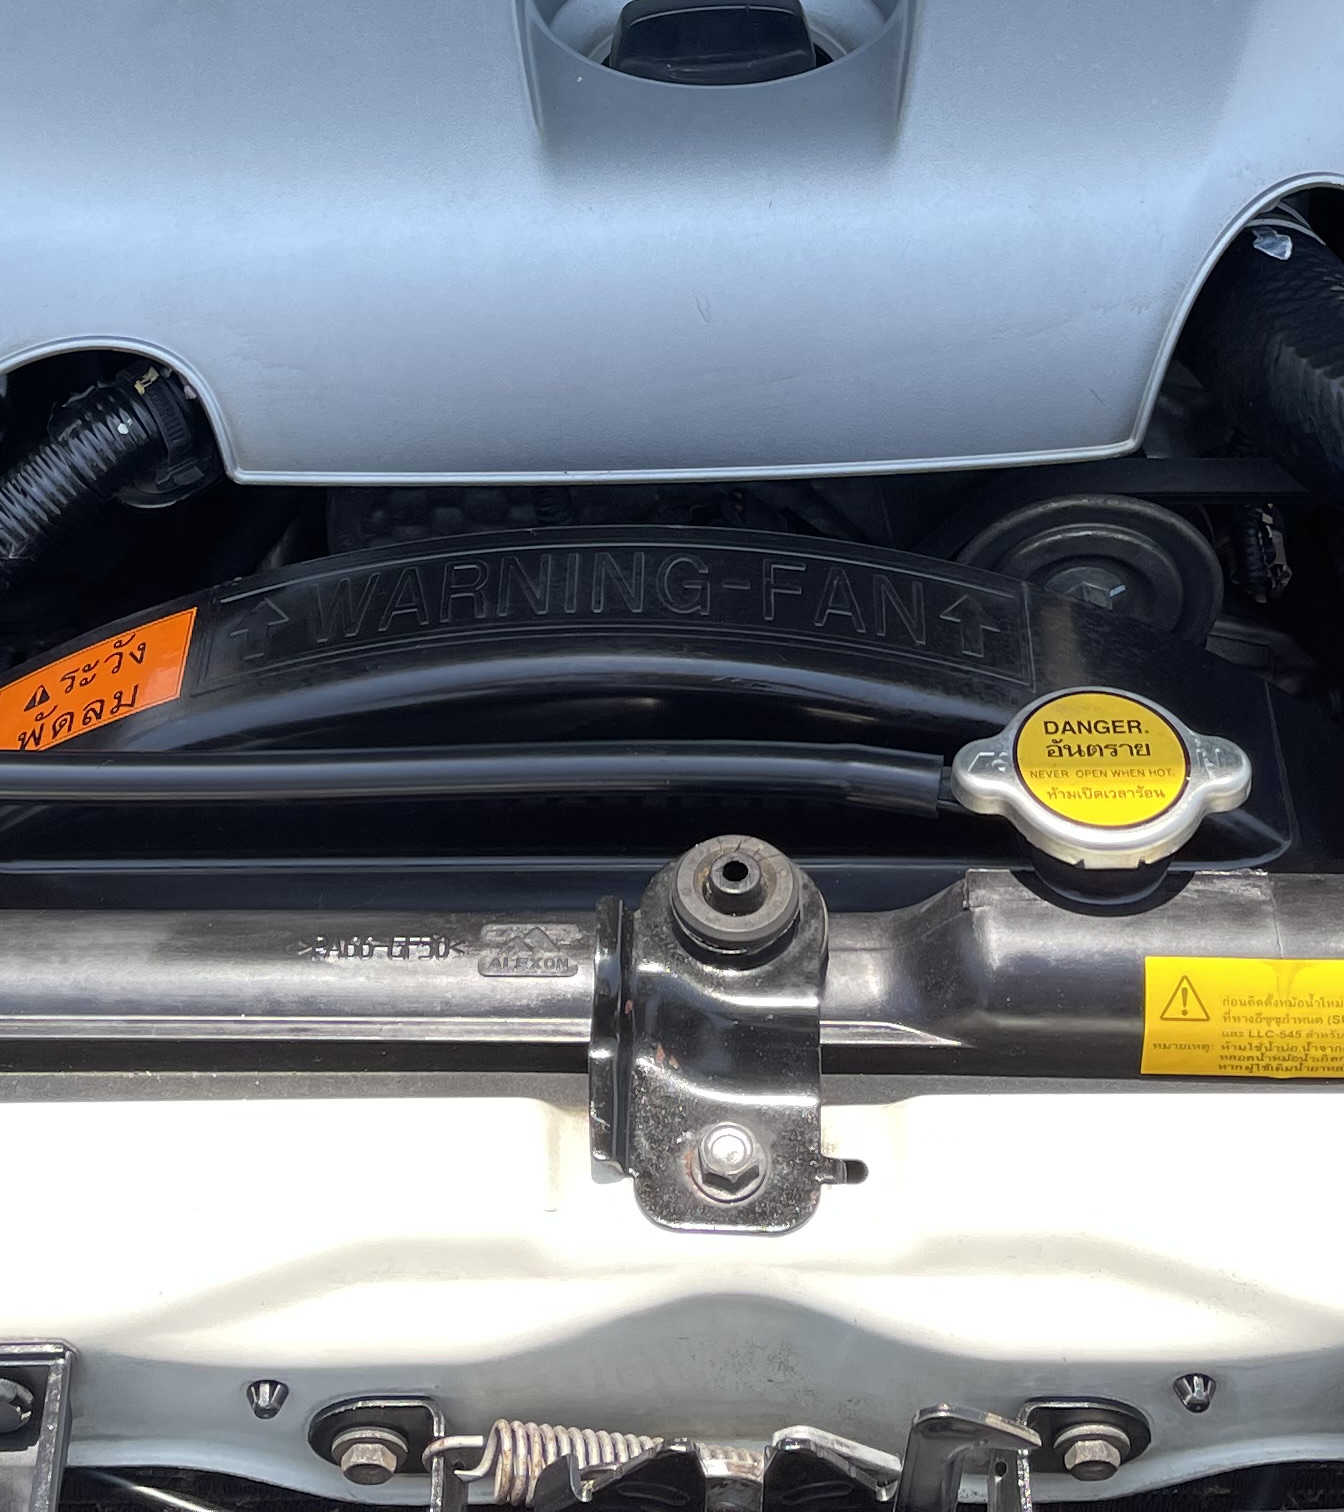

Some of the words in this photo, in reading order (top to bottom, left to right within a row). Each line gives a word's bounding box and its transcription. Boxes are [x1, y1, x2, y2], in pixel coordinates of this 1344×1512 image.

[60, 633, 147, 694] ระวัง
[18, 684, 140, 751] พัดลม
[1044, 720, 1150, 734] DANGER.
[1046, 739, 1151, 758] อันตราย
[1030, 770, 1069, 780] NEVER
[1076, 769, 1106, 778] OPEN
[1110, 768, 1144, 778] WHEN
[1046, 786, 1166, 801] ห้ามเปิดเวลาร้อน
[488, 957, 570, 971] ALEXON
